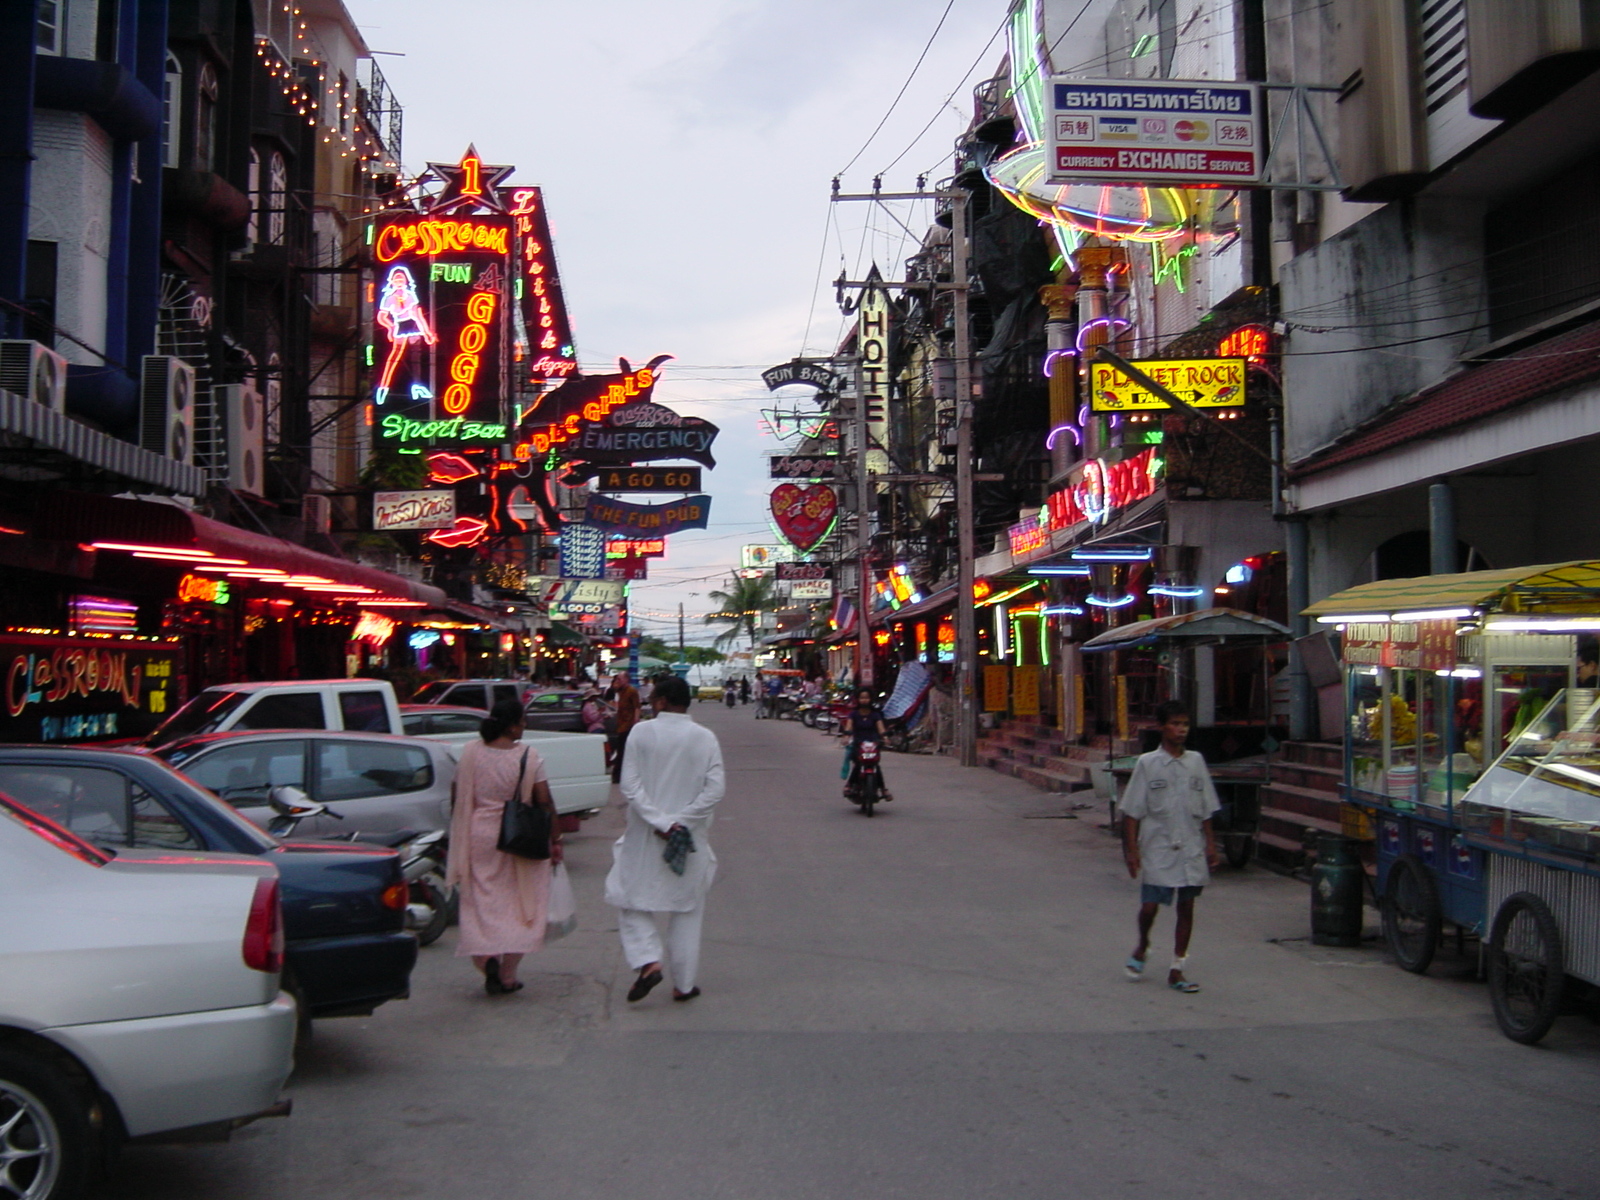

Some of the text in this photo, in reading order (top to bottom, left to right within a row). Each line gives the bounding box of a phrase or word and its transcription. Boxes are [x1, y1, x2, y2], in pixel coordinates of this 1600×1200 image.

[1066, 89, 1240, 111] ธนาคารทหารไทย
[1108, 125, 1128, 134] VISA
[1061, 151, 1250, 172] CURRENCY EXCHANGE SERVICE
[460, 158, 481, 195] 1
[430, 263, 472, 284] FUN
[765, 367, 831, 386] FUN BAR
[862, 311, 885, 450] HOTEL
[1184, 364, 1241, 386] ROCK
[583, 369, 653, 422] GIRLS
[381, 414, 465, 443] Sport
[460, 423, 506, 441] Bar
[583, 430, 712, 453] EMERGENCY
[608, 472, 693, 488] A GO GO
[592, 505, 701, 528] THE FUN PUB
[793, 580, 829, 590] PALMER'S
